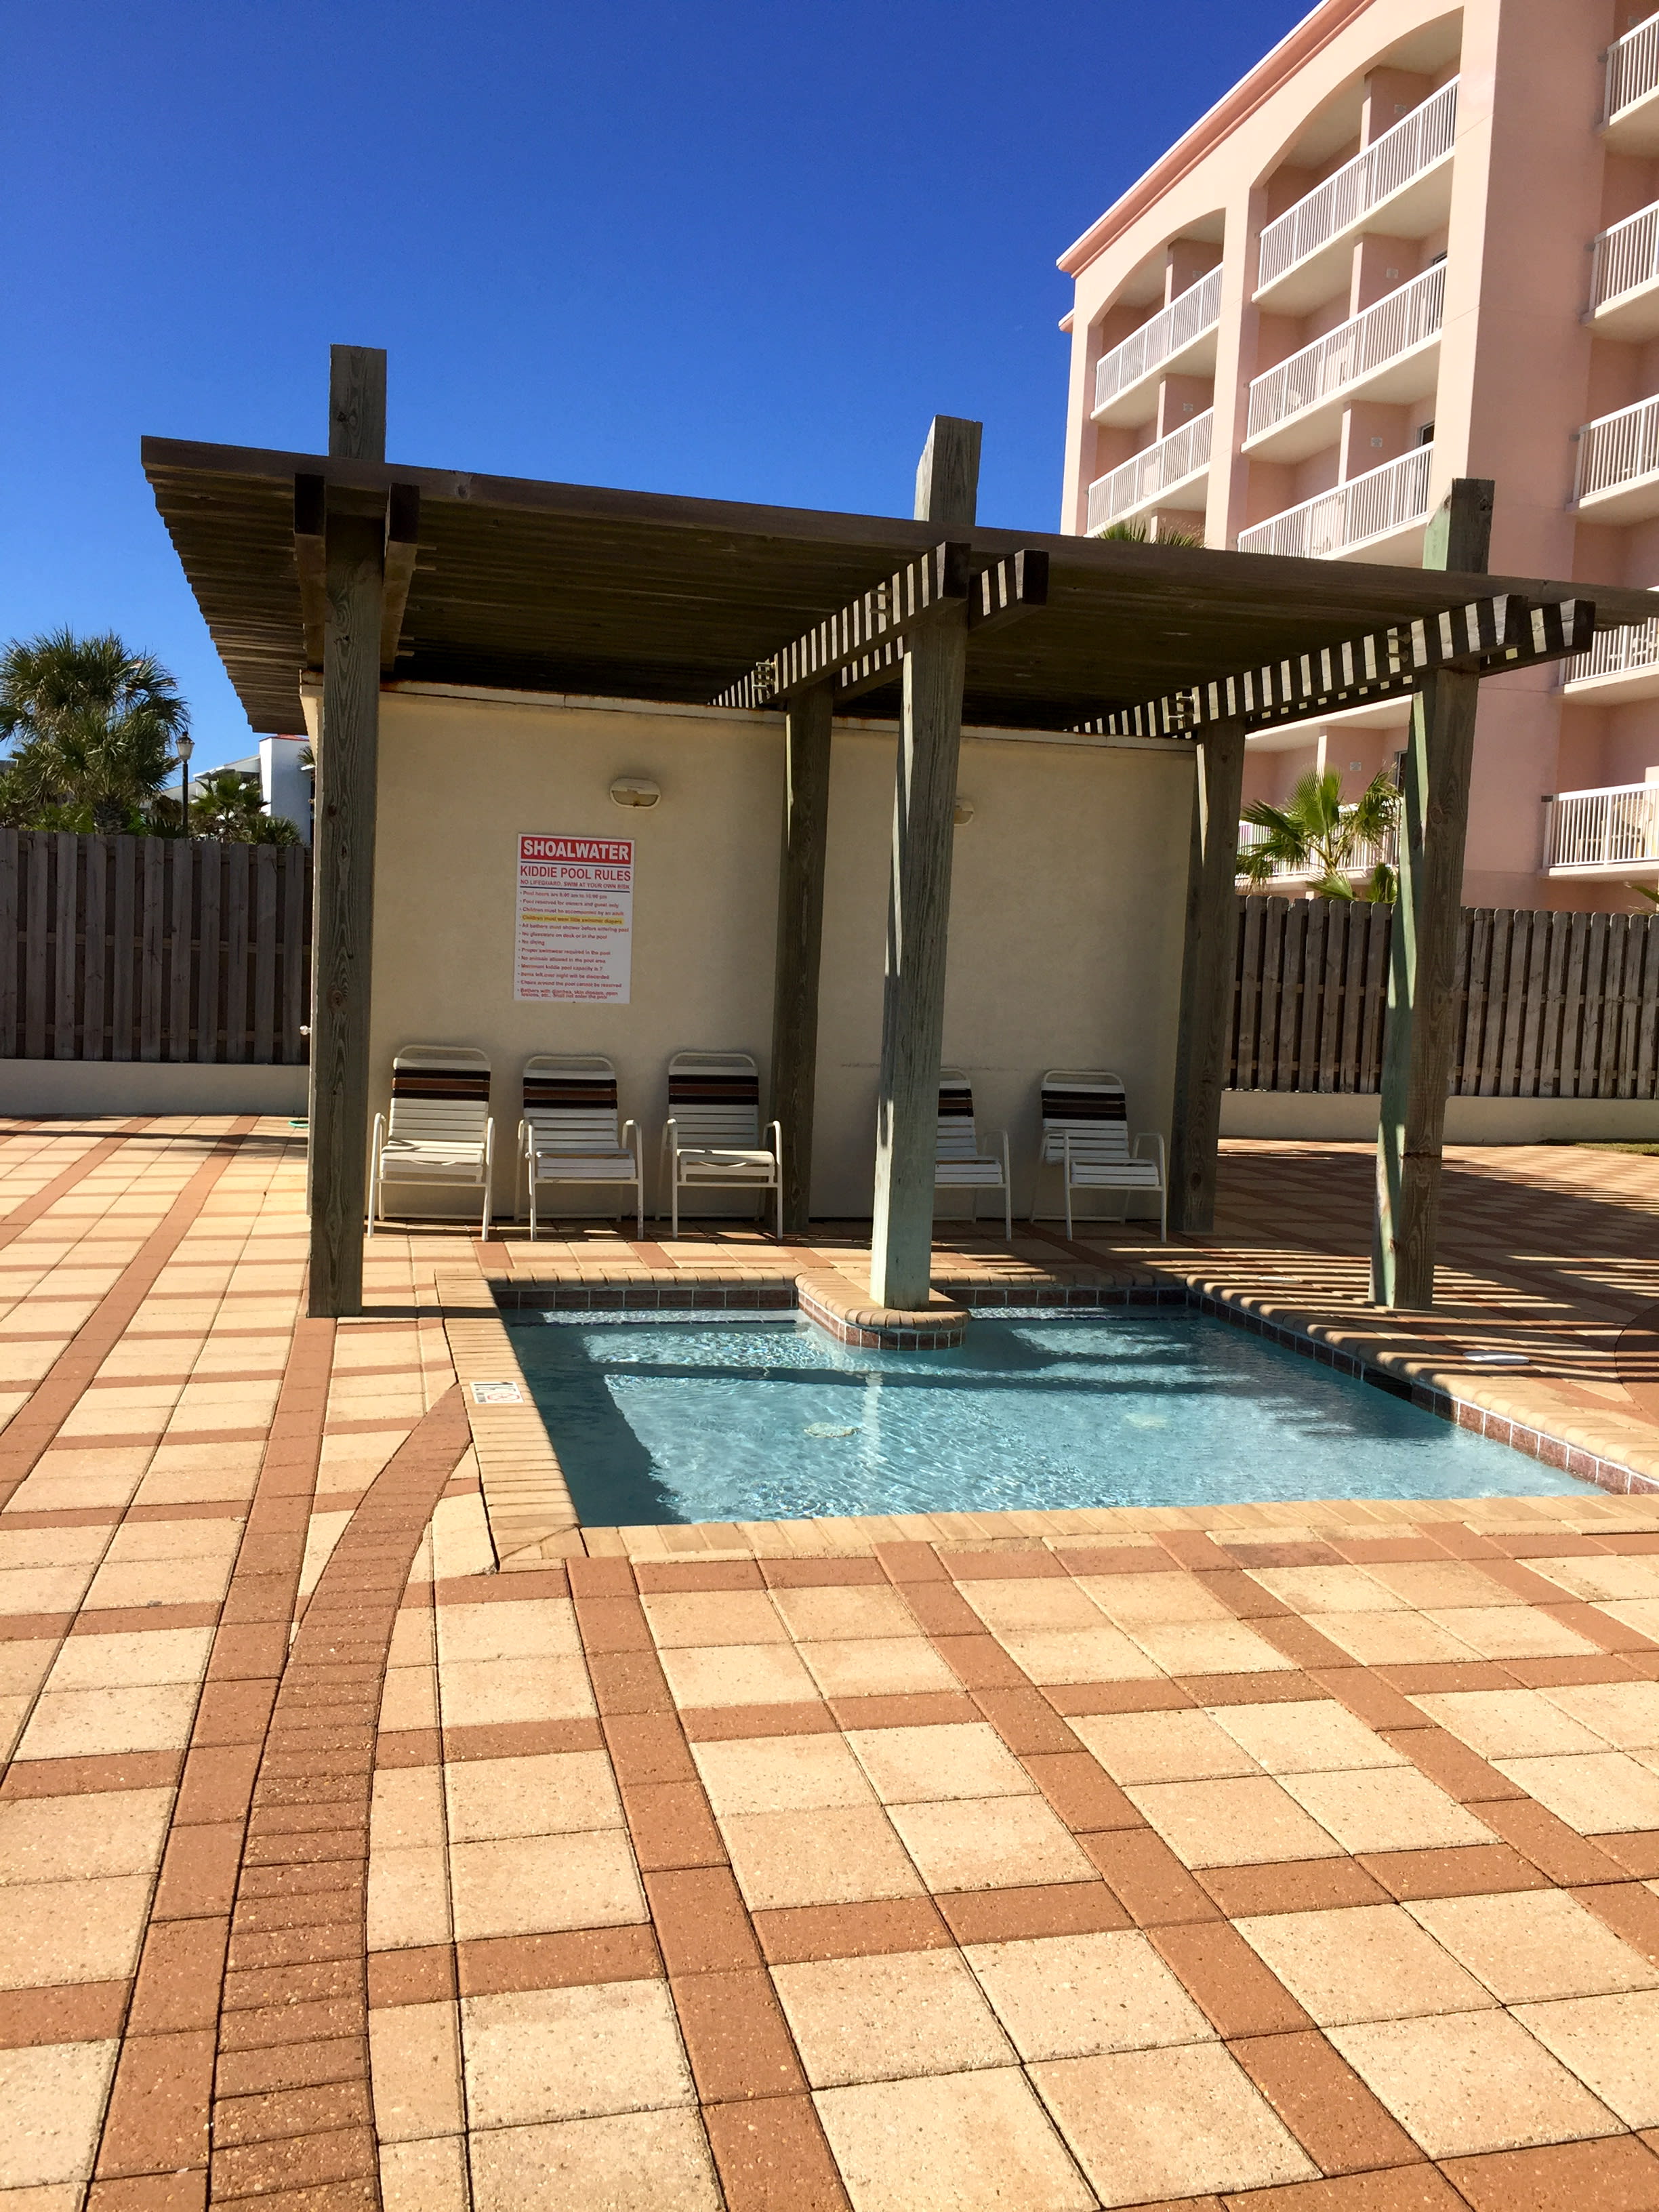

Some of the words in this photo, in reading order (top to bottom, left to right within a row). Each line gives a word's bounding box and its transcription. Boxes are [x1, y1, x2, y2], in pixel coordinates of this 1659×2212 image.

[523, 839, 629, 861] SHOALWATER
[520, 865, 557, 878] KIDDIE
[561, 867, 591, 880] POOL
[594, 869, 631, 881] RULES
